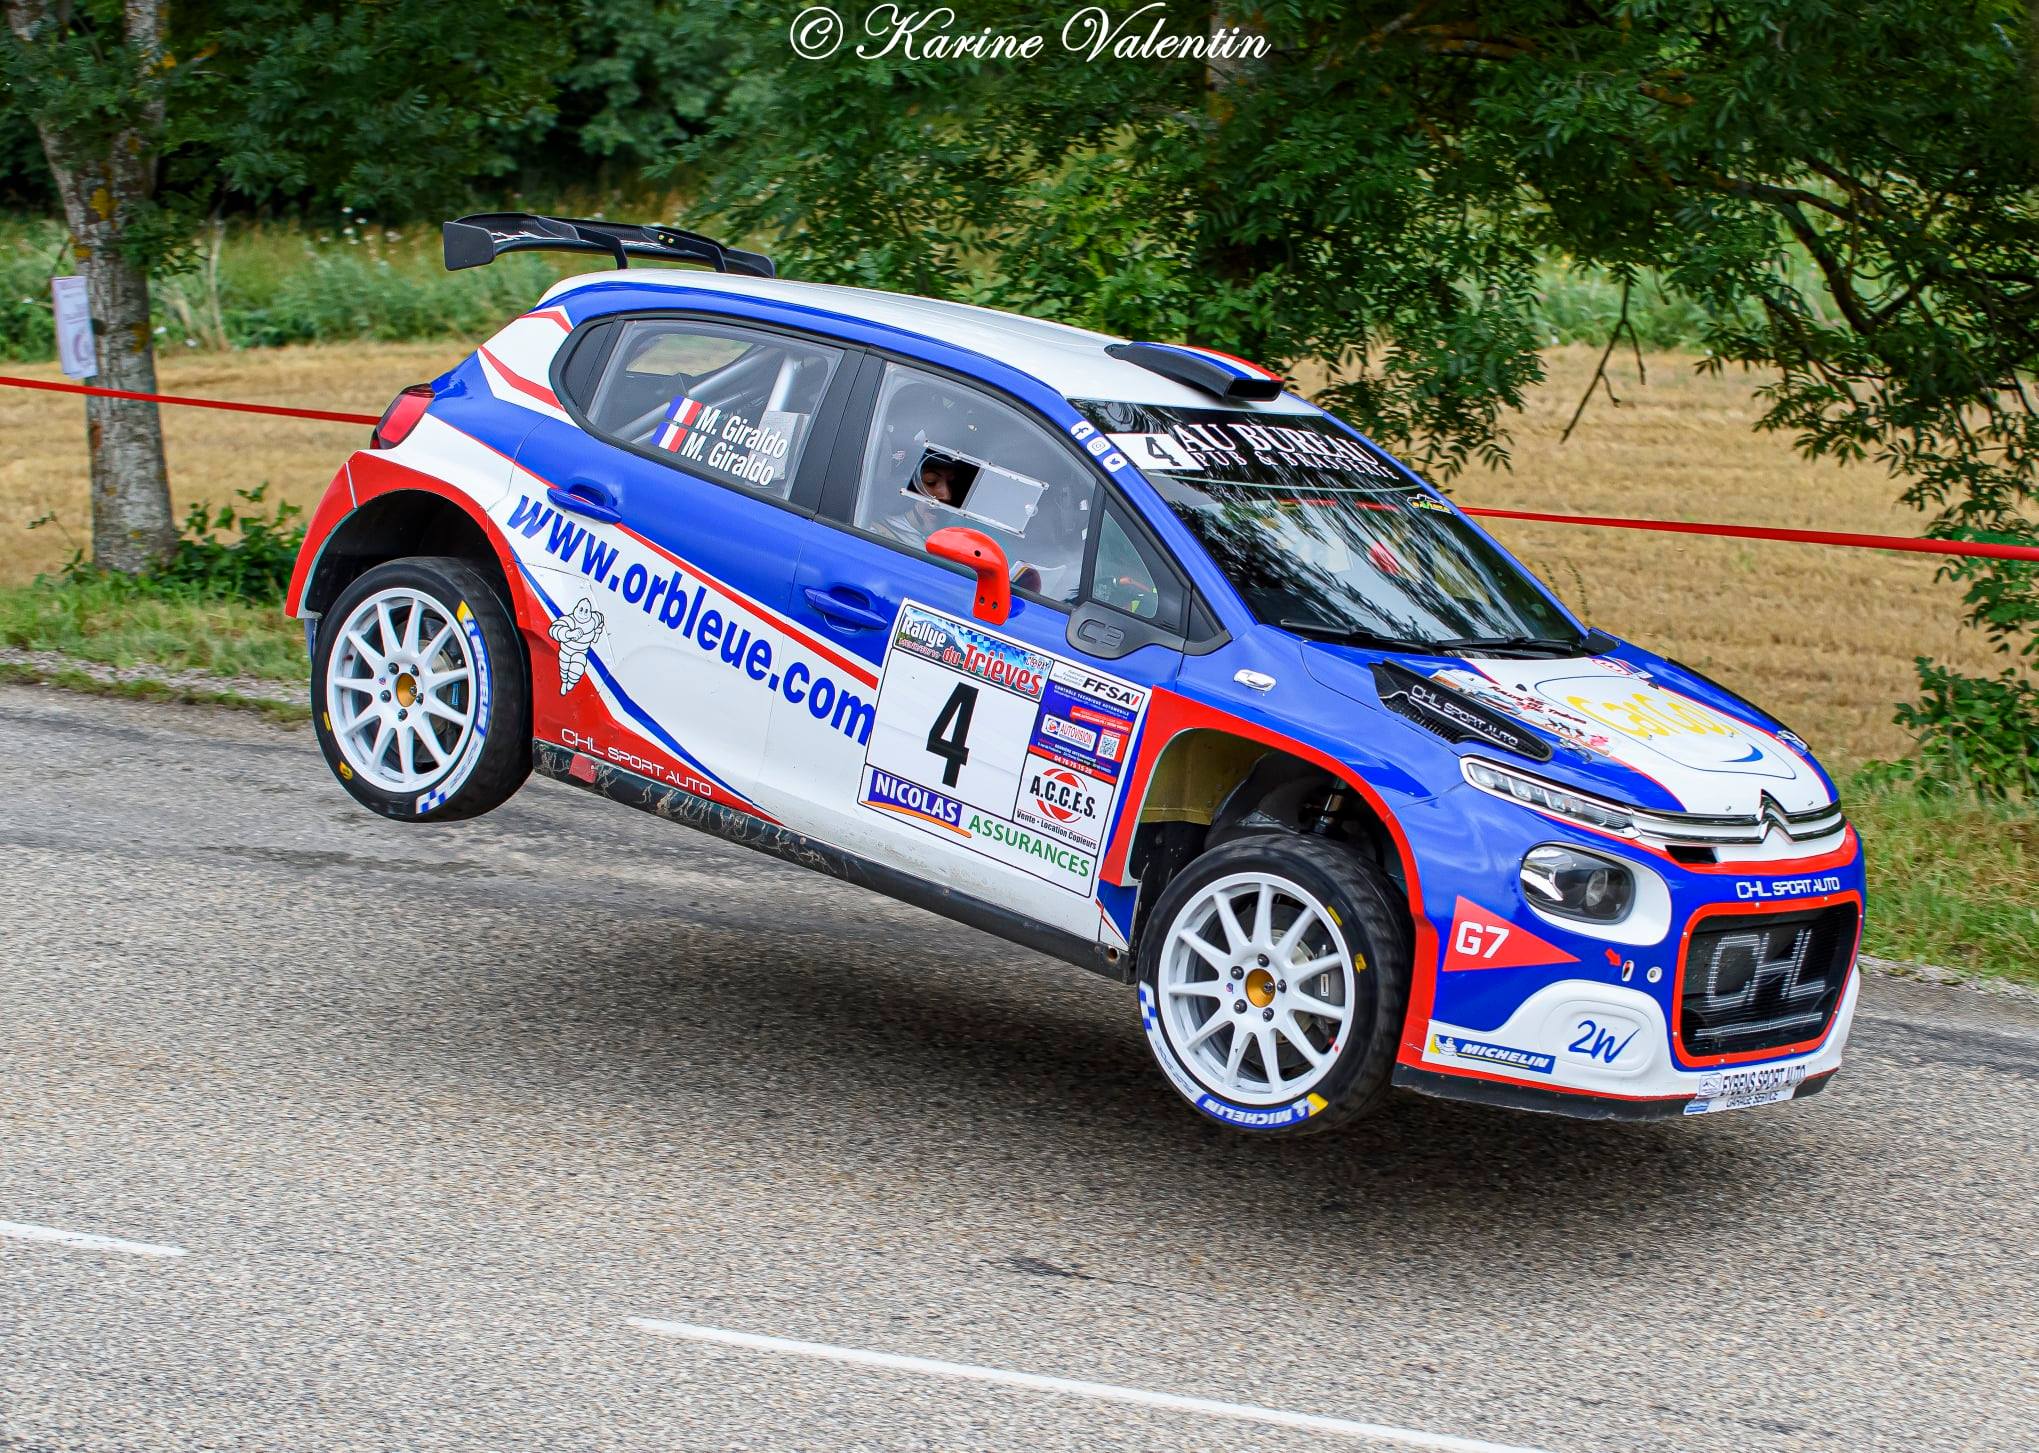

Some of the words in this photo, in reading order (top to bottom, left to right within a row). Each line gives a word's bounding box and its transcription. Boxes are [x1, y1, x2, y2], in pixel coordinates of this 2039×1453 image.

[695, 405, 721, 436] M.
[721, 415, 788, 459] Giraldo
[1145, 436, 1182, 467] 4
[1173, 423, 1237, 452] AU
[1227, 423, 1379, 466] BUREAU
[680, 431, 707, 462] M.
[707, 441, 775, 486] Giraldo
[1190, 450, 1248, 467] PUB
[1254, 450, 1278, 466] &
[1277, 451, 1400, 480] BRASSERIE
[506, 494, 875, 747] www.orbleue.com
[901, 615, 947, 648] Rallye
[942, 645, 961, 667] du
[962, 642, 1043, 696] Trièves
[1081, 677, 1132, 705] FFSA
[925, 681, 980, 789] 4
[1060, 722, 1093, 745] AUTOVISION
[1411, 684, 1442, 709] CHL
[1443, 702, 1487, 729] SPORT
[1484, 724, 1519, 746] AUTO
[561, 728, 605, 756] CHL
[607, 746, 665, 777] SPORT
[665, 770, 712, 796] AUTO
[1029, 774, 1096, 820] A.C.C.E.S.
[874, 772, 958, 823] NICOLAS
[968, 814, 1090, 878] ASSURANCES
[1016, 809, 1036, 824] Vente
[1040, 819, 1068, 838] Location
[1068, 831, 1097, 850] Copieurs
[1735, 880, 1773, 899] CHL
[1771, 879, 1812, 896] SPORT
[1812, 876, 1841, 893] AUTO
[1455, 920, 1510, 959] G7
[1460, 1043, 1550, 1069] MICHELIN
[1202, 1097, 1293, 1125] MICHELIN
